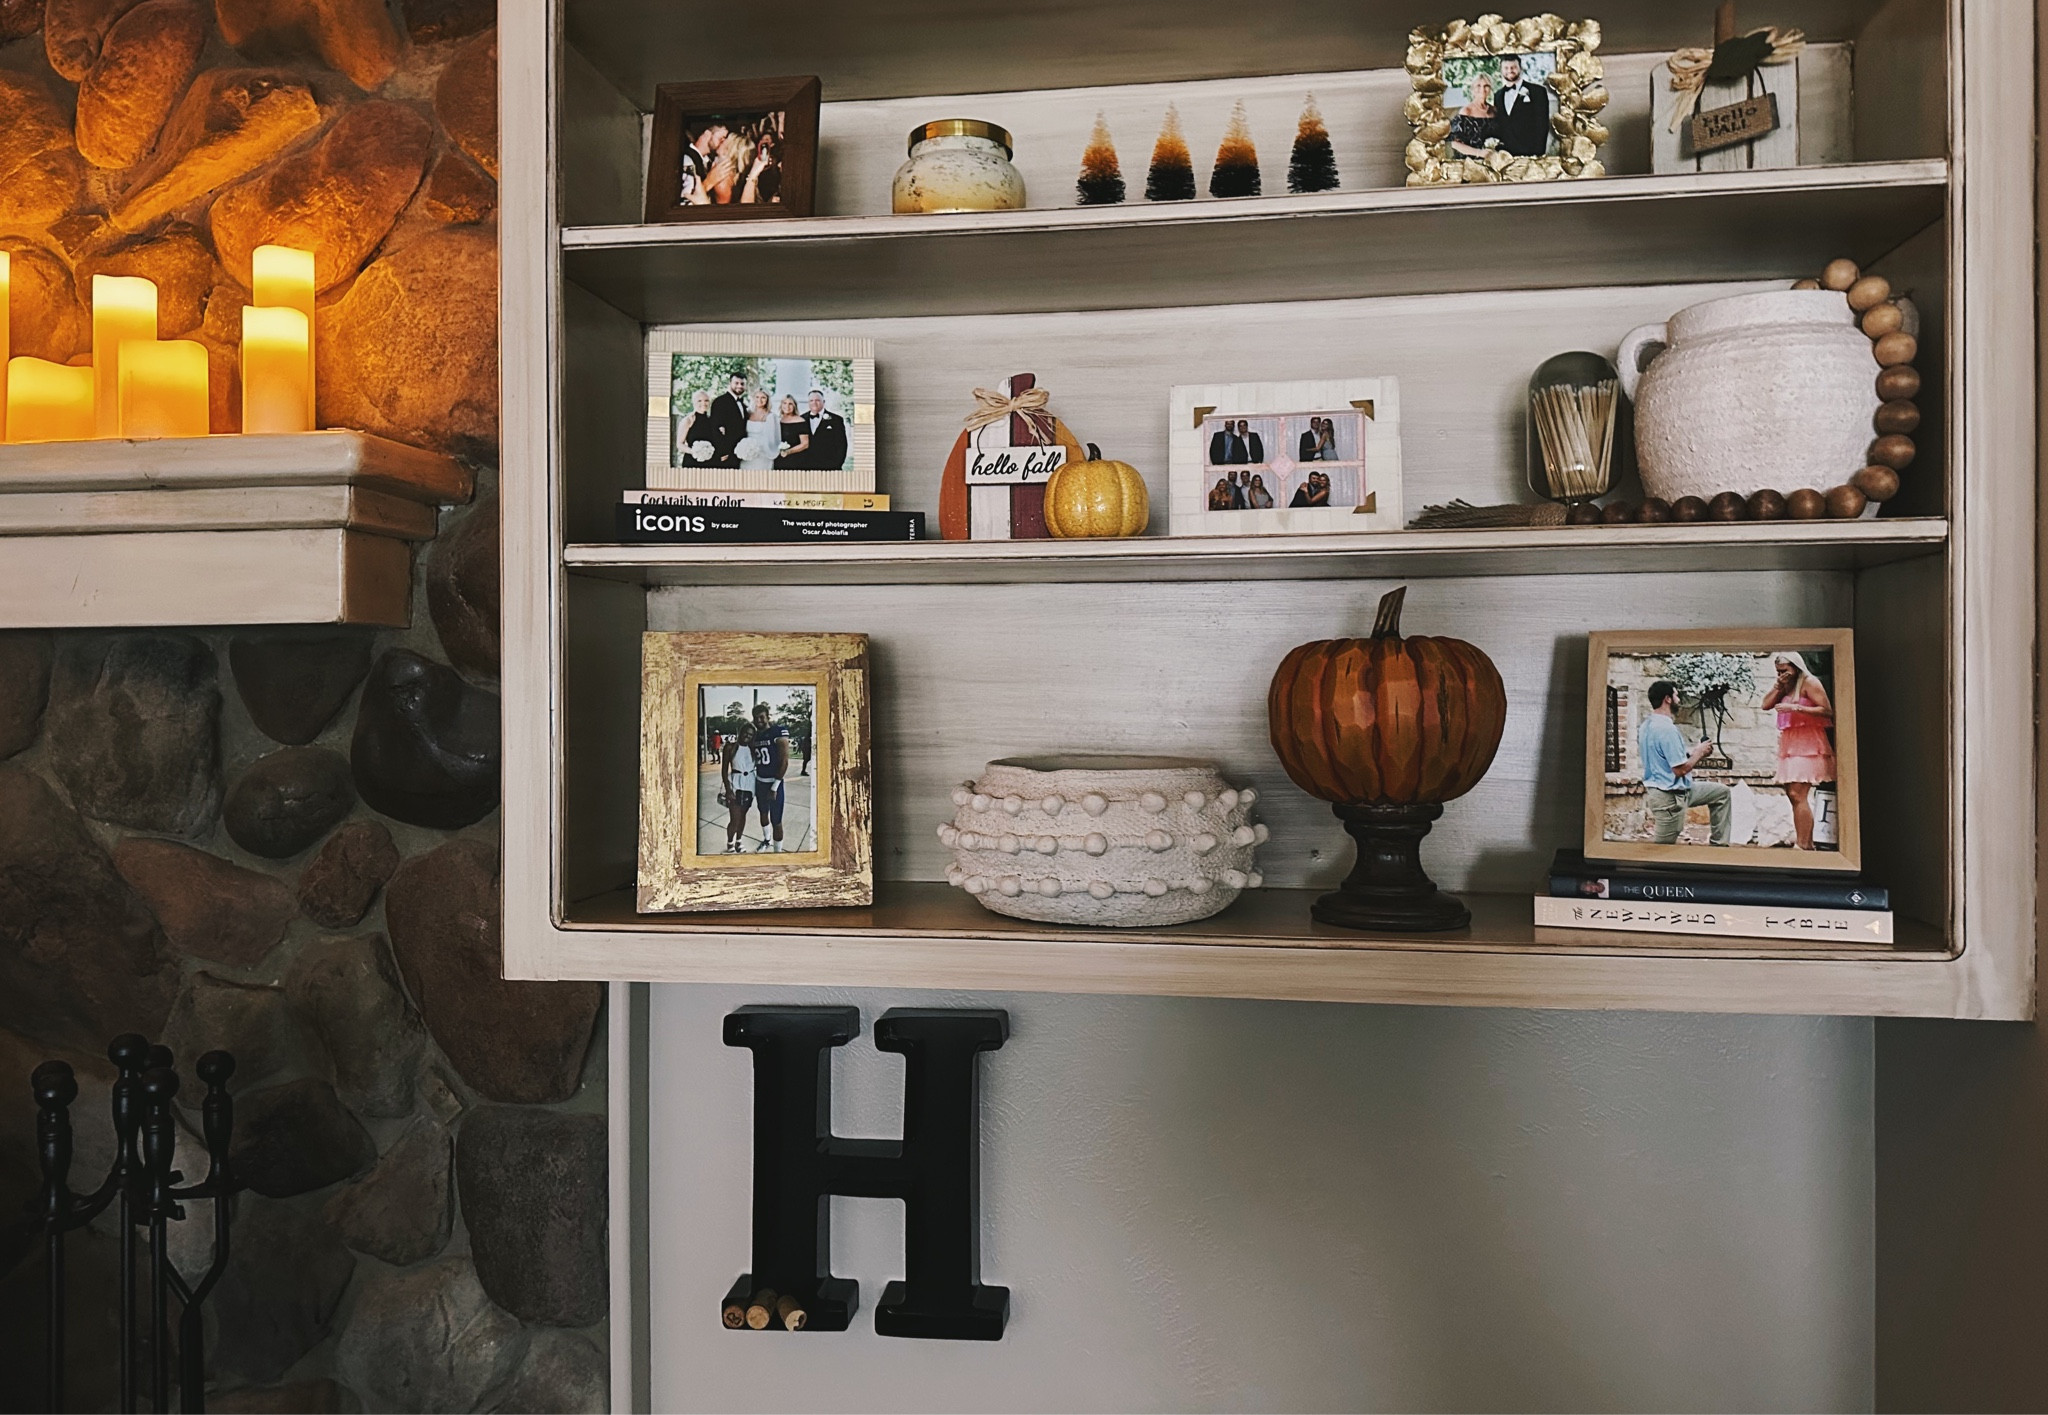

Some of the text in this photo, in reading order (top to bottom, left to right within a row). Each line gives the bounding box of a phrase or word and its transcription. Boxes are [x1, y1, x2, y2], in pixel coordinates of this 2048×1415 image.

[971, 451, 1061, 480] hello fall
[712, 495, 745, 508] Color
[635, 508, 705, 532] icons
[711, 522, 720, 530] by
[1623, 885, 1695, 899] THE QUEEN
[1573, 906, 1848, 930] The NEWLYWED TABLE
[722, 1005, 1010, 1341] H
